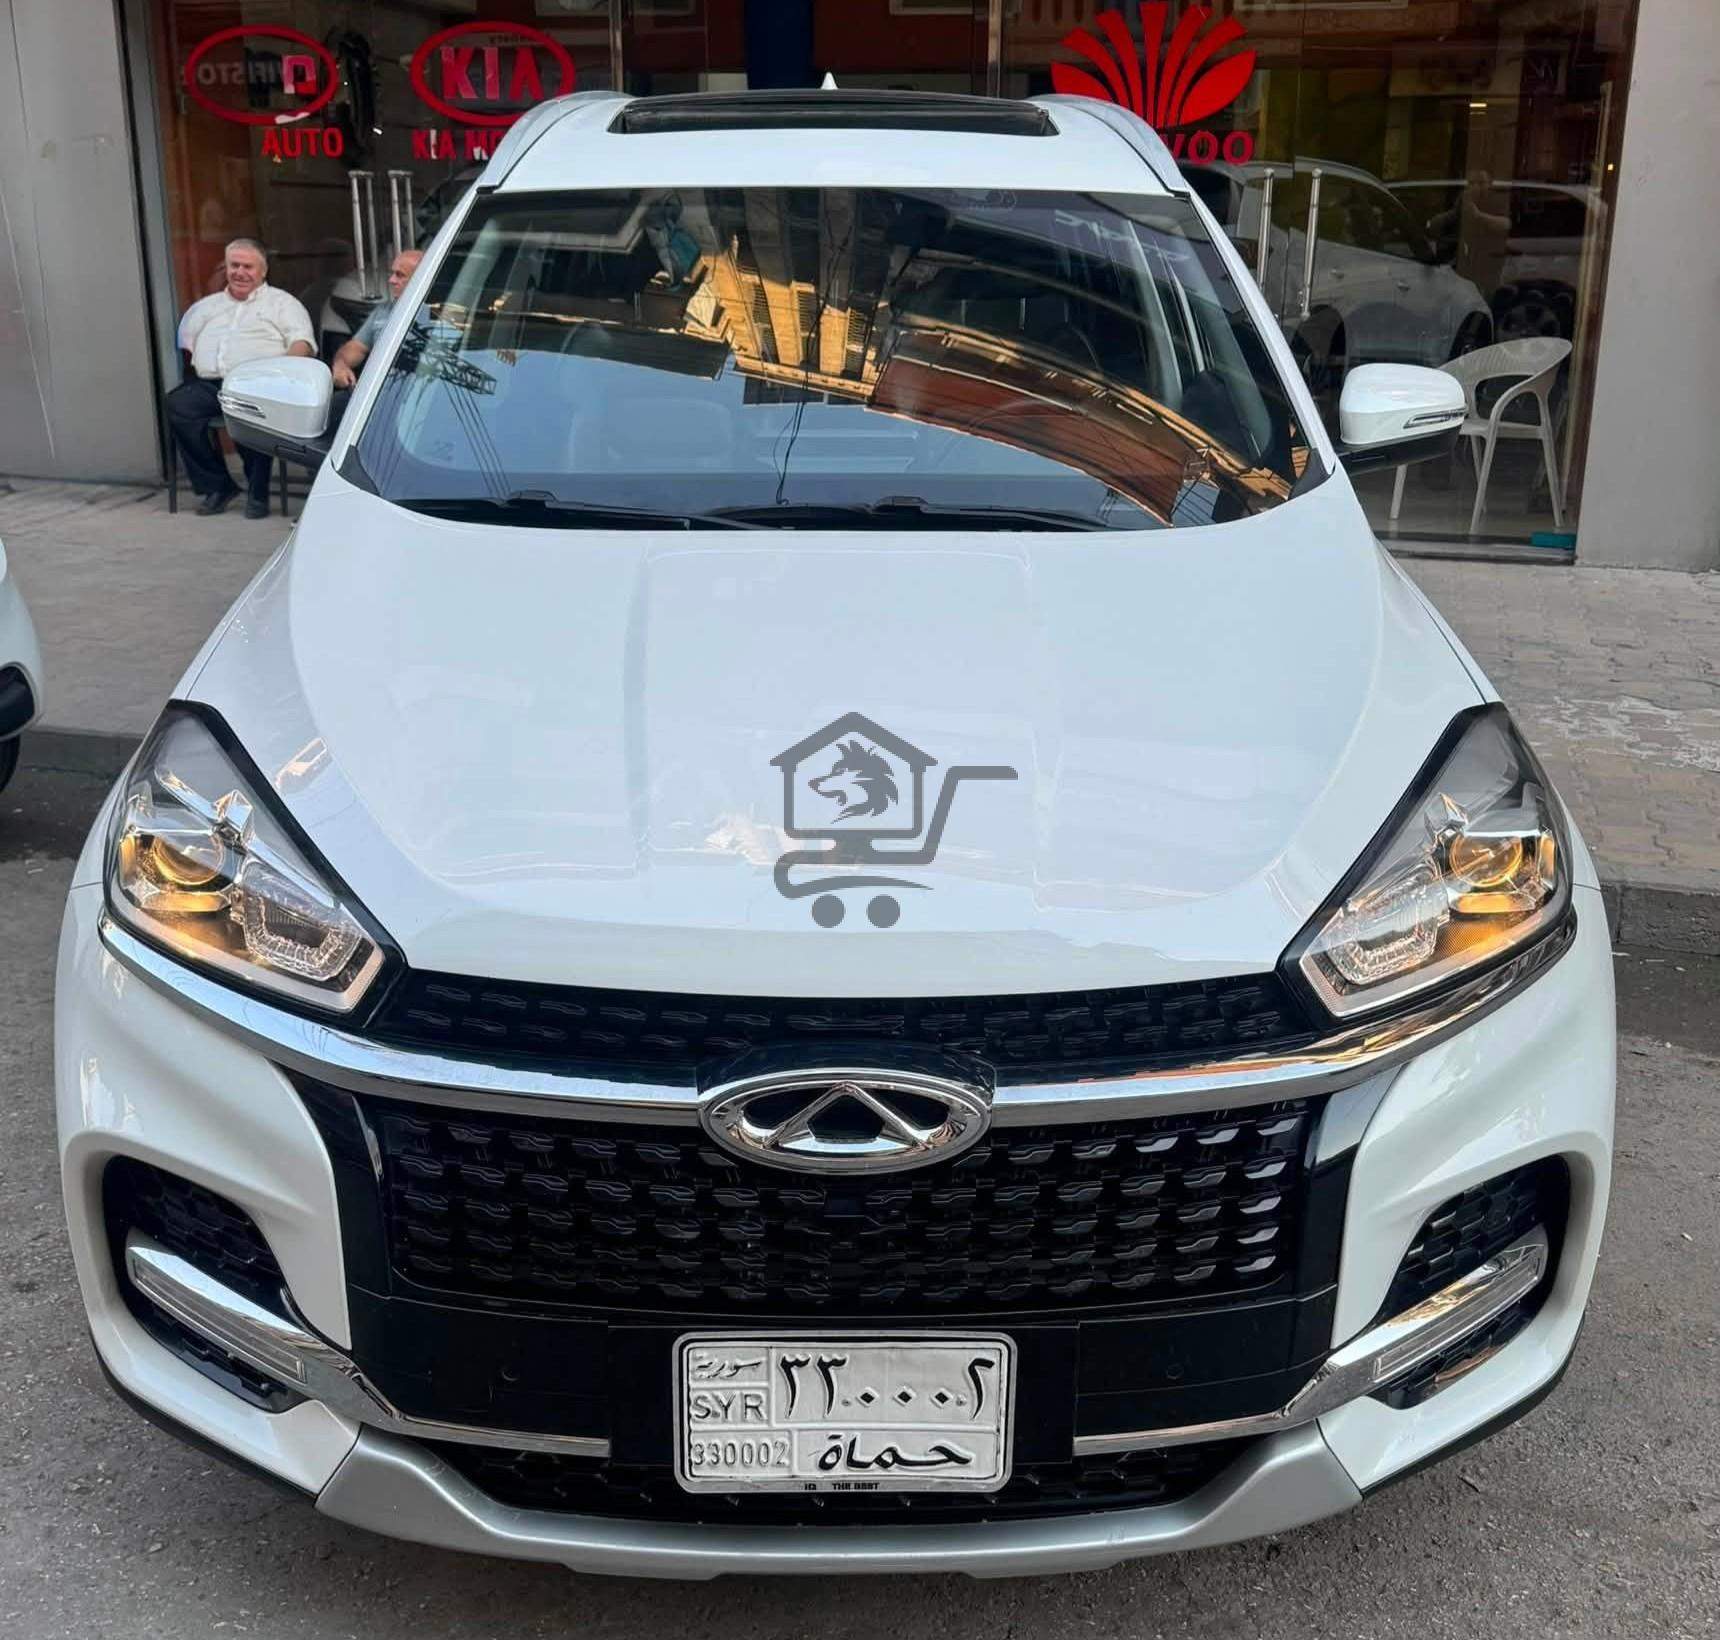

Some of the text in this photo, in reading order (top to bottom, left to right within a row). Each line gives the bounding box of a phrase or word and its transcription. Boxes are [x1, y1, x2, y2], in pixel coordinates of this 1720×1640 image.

[440, 46, 546, 101] KIA
[262, 126, 345, 160] AUTO
[411, 128, 456, 160] KIA
[692, 1393, 765, 1419] SYR
[692, 1441, 790, 1466] 330002
[818, 1434, 974, 1471] حماة
